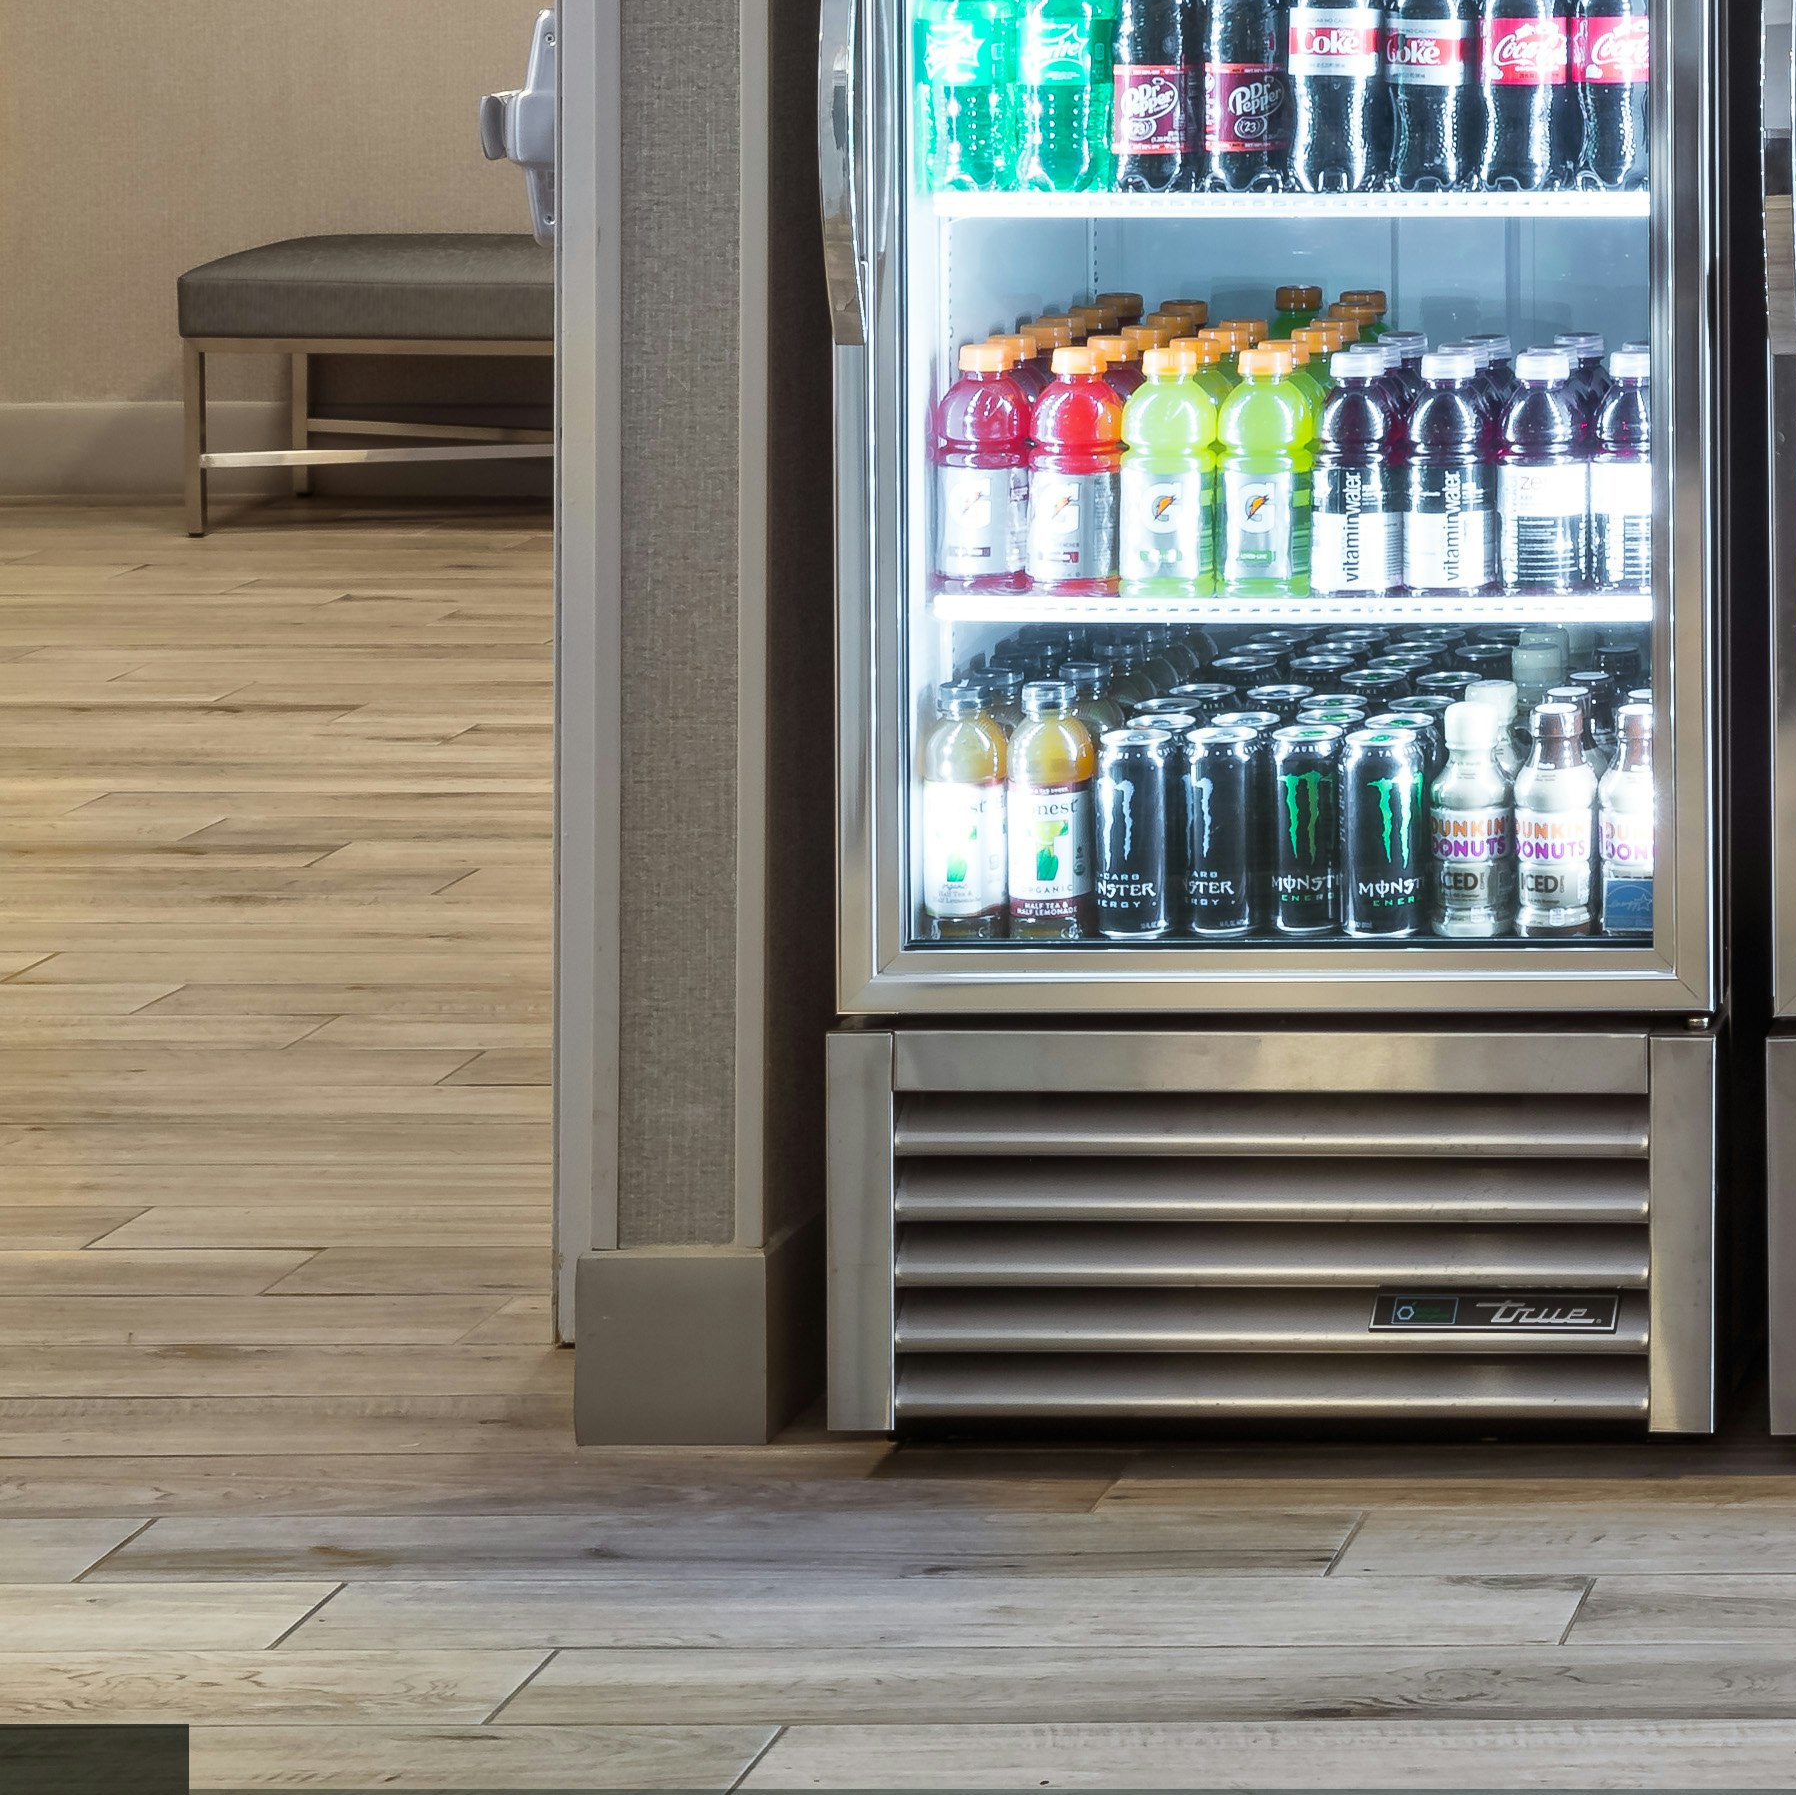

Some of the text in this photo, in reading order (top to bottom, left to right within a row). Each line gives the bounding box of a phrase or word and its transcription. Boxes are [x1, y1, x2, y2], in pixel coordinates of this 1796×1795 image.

[1387, 37, 1440, 66] Coke
[1243, 122, 1257, 132] 23
[1345, 472, 1361, 582] vitaminwater
[1445, 470, 1461, 582] vitaminwater
[1433, 837, 1505, 857] DONUTS
[1521, 872, 1558, 893] ICED
